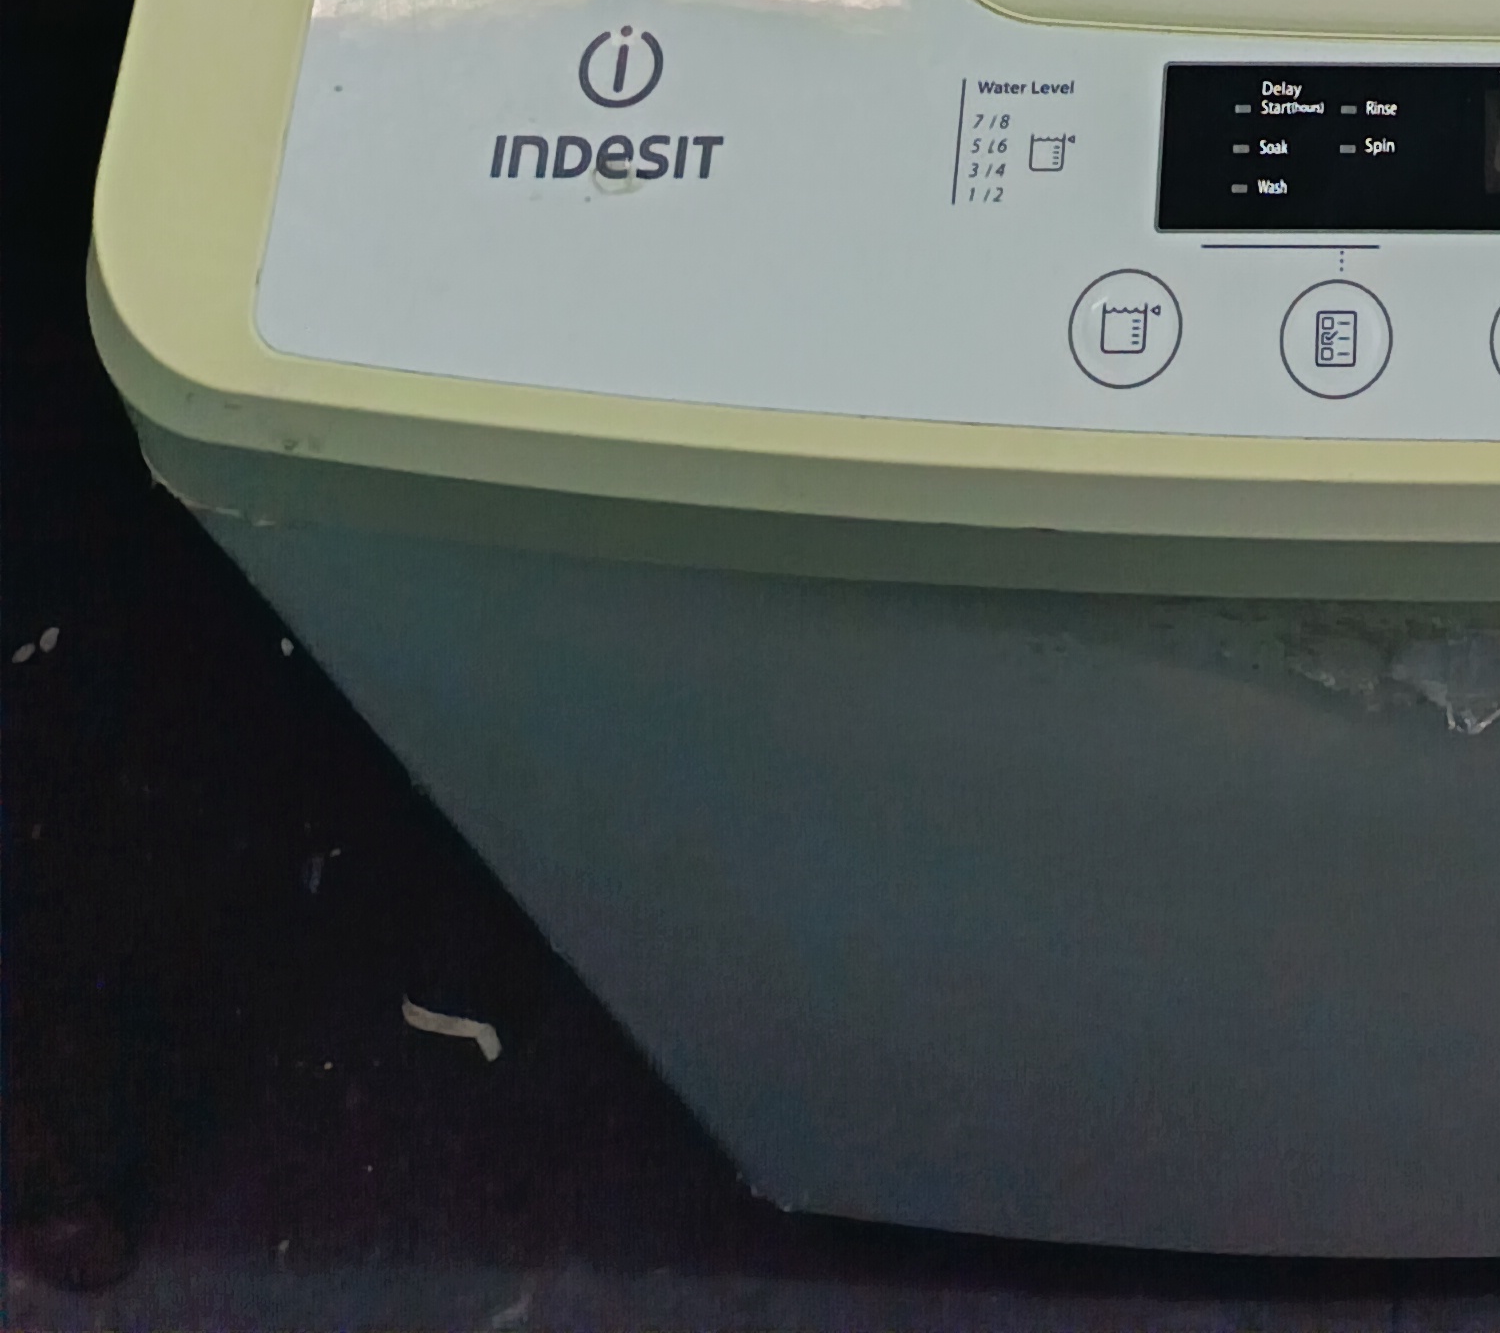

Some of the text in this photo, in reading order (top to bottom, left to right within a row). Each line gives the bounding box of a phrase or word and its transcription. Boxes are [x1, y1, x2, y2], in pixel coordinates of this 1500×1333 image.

[978, 80, 1075, 94] Water Level
[1262, 81, 1302, 99] Delay
[1366, 100, 1398, 115] Rinse
[1259, 139, 1288, 154] Soak
[1365, 138, 1395, 156] Spin
[1257, 179, 1288, 194] Wash
